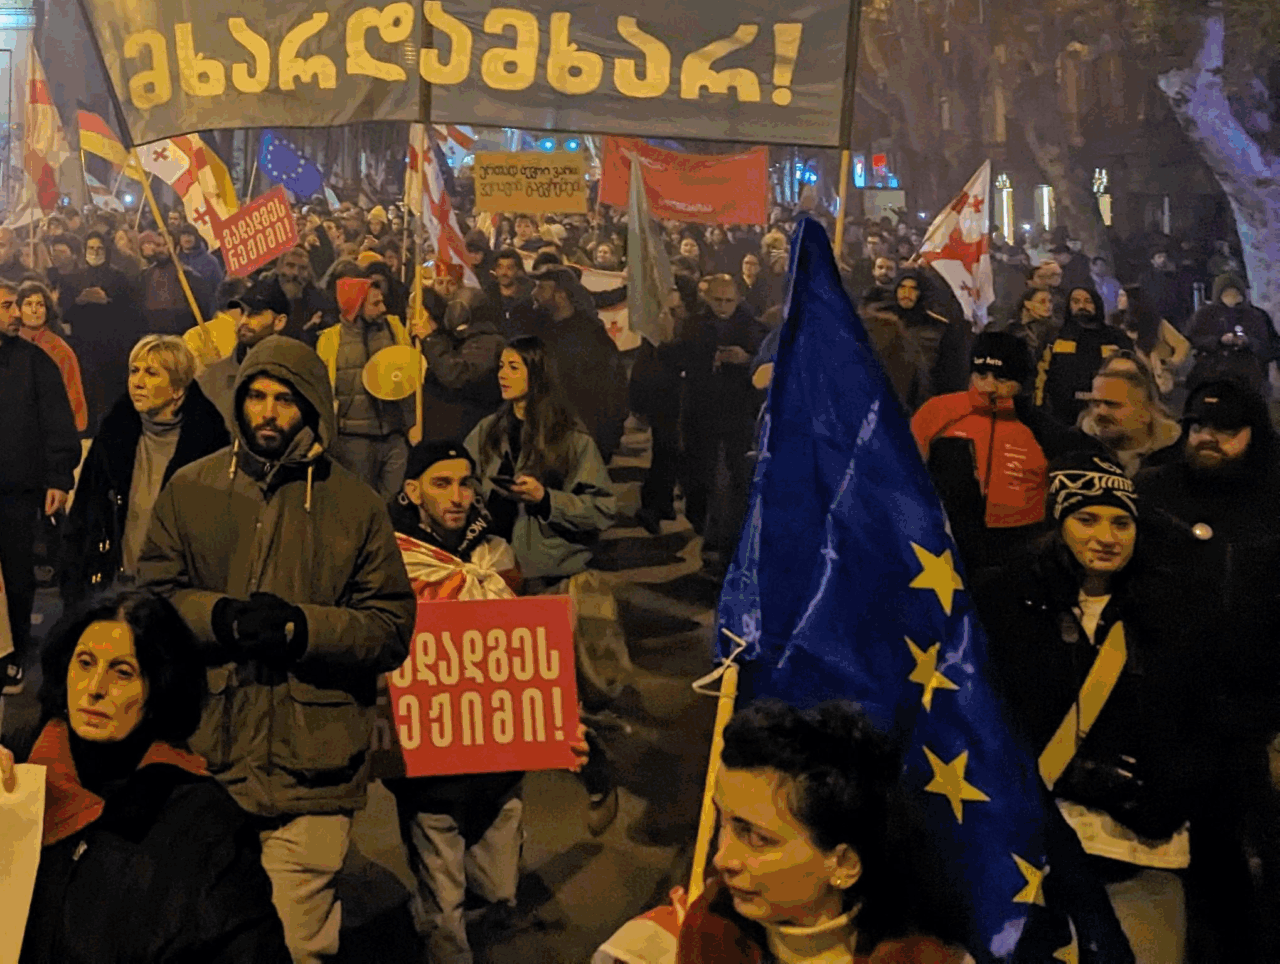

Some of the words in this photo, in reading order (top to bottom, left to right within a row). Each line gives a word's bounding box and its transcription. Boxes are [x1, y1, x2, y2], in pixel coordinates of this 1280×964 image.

[123, 1, 803, 111] მხარდამხარ!
[222, 197, 287, 249] გადადგეს
[227, 217, 293, 272] რეჟიმი!
